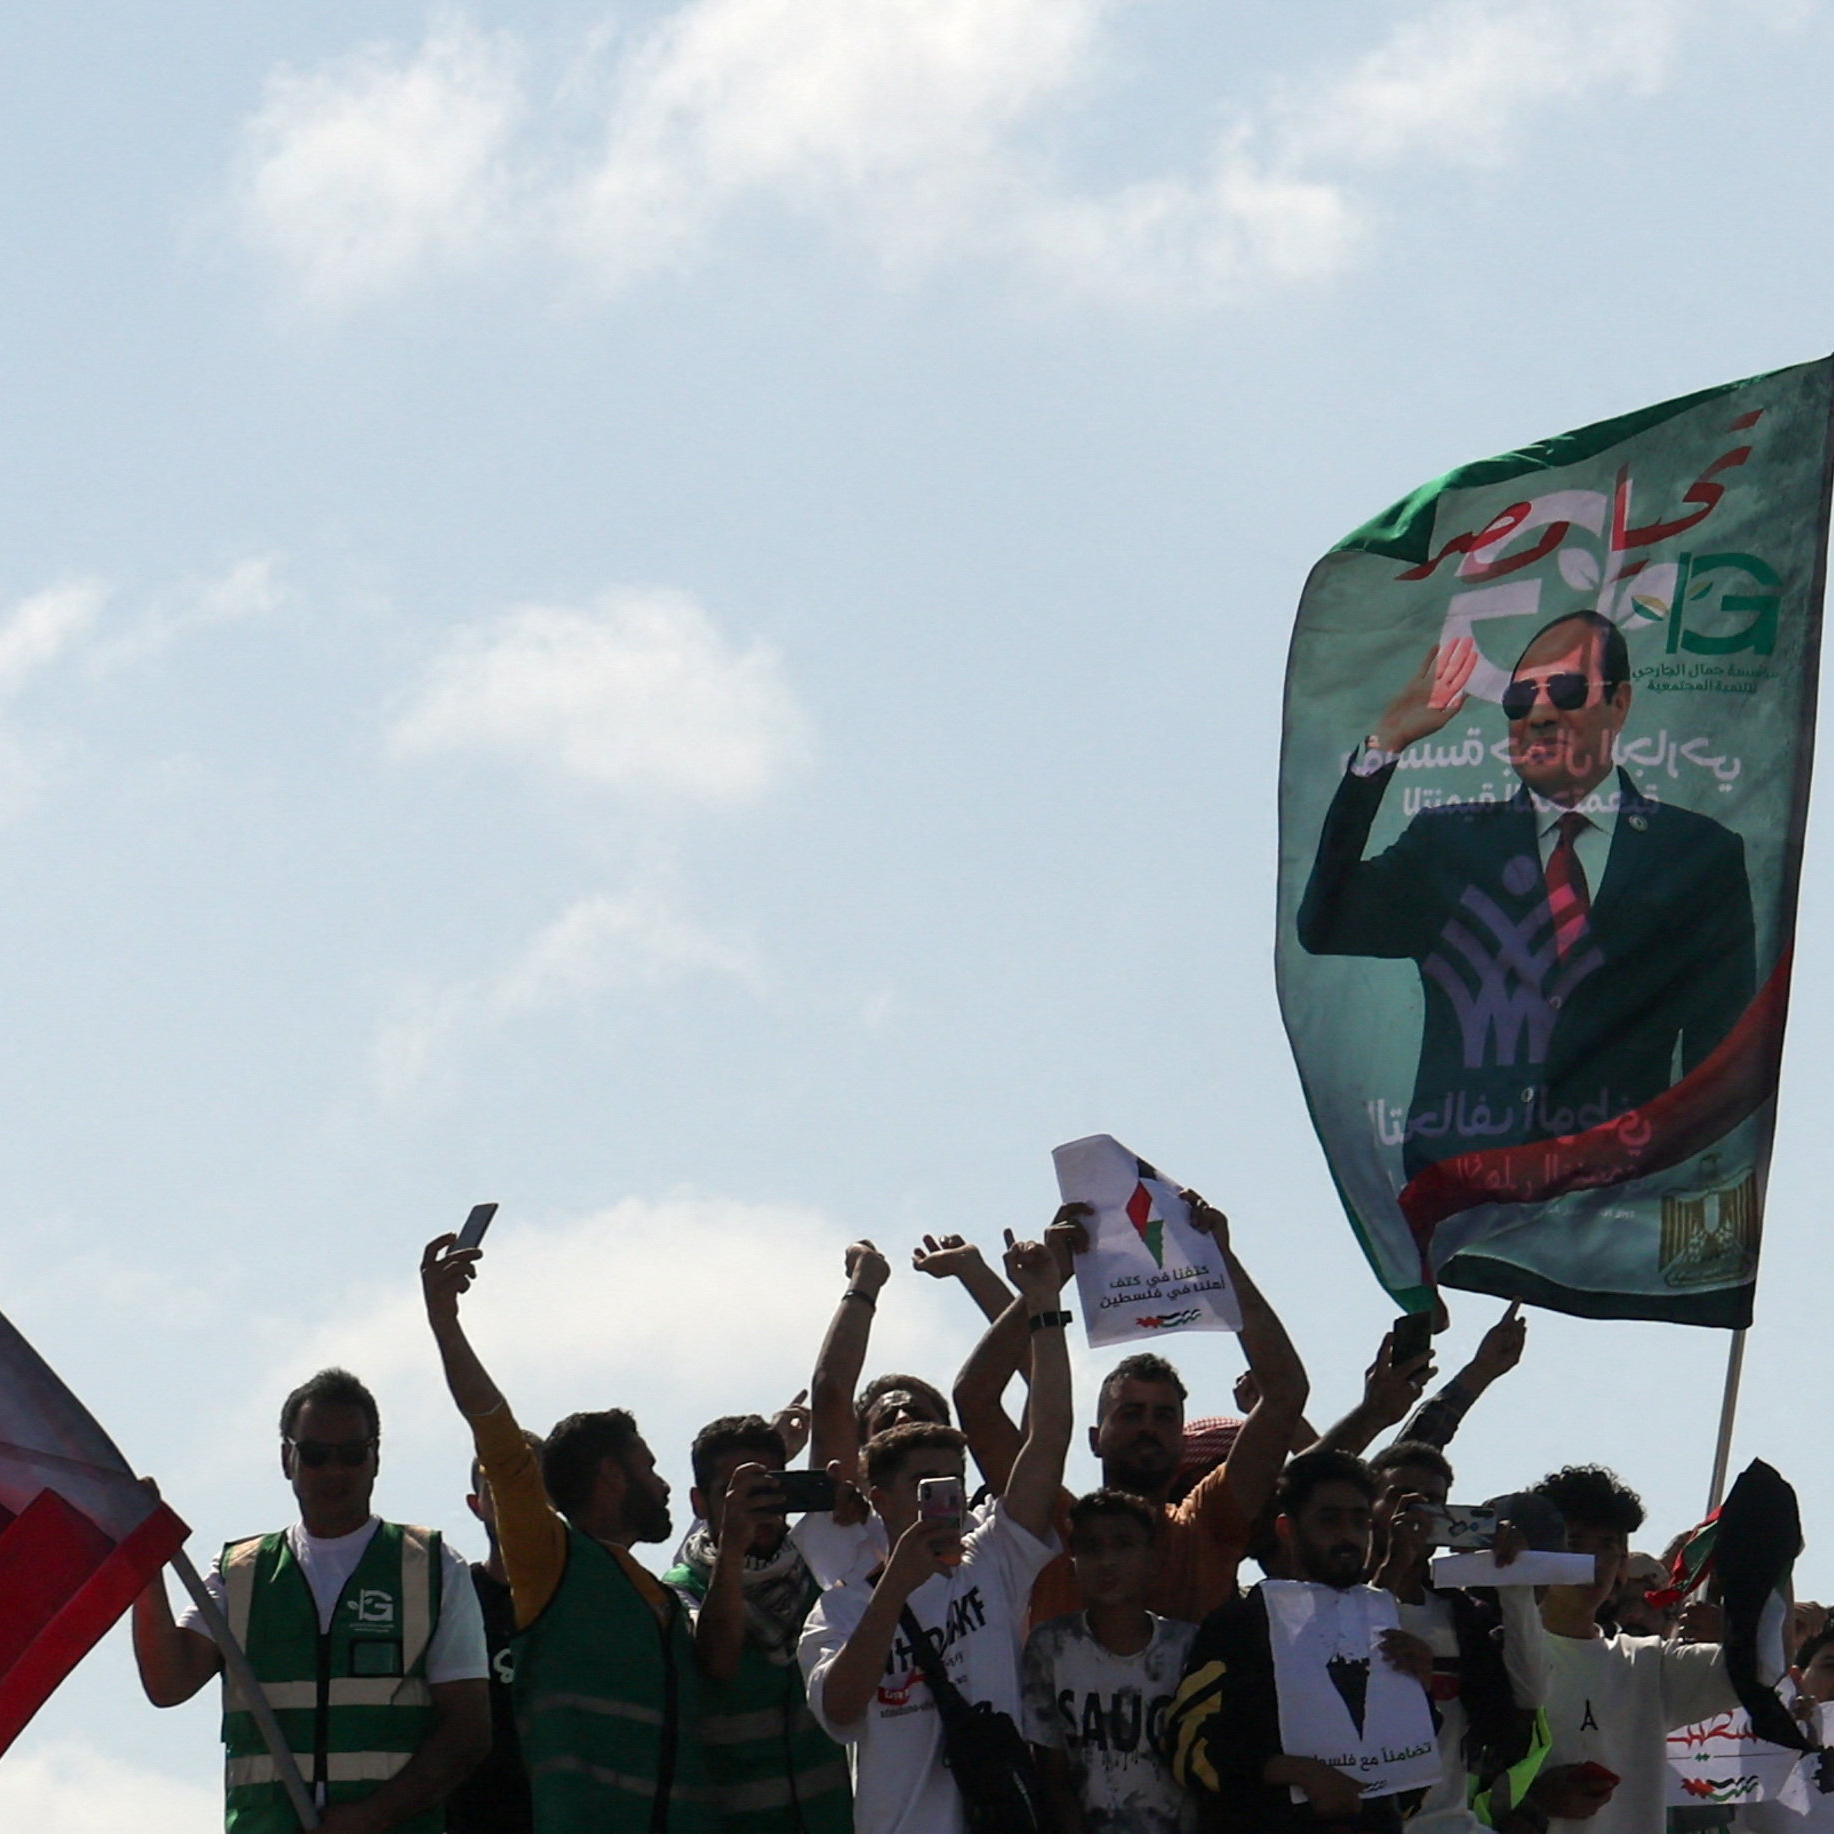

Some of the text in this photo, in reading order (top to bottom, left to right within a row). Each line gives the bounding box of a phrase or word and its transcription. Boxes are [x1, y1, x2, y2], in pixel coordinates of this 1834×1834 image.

[1632, 664, 1685, 680] الجارحي
[1689, 664, 1724, 678] جمال
[1110, 1266, 1210, 1288] كتفنا في كتف
[1100, 1275, 1226, 1309] أهلنا في فلسطين
[1360, 1756, 1379, 1771] مع
